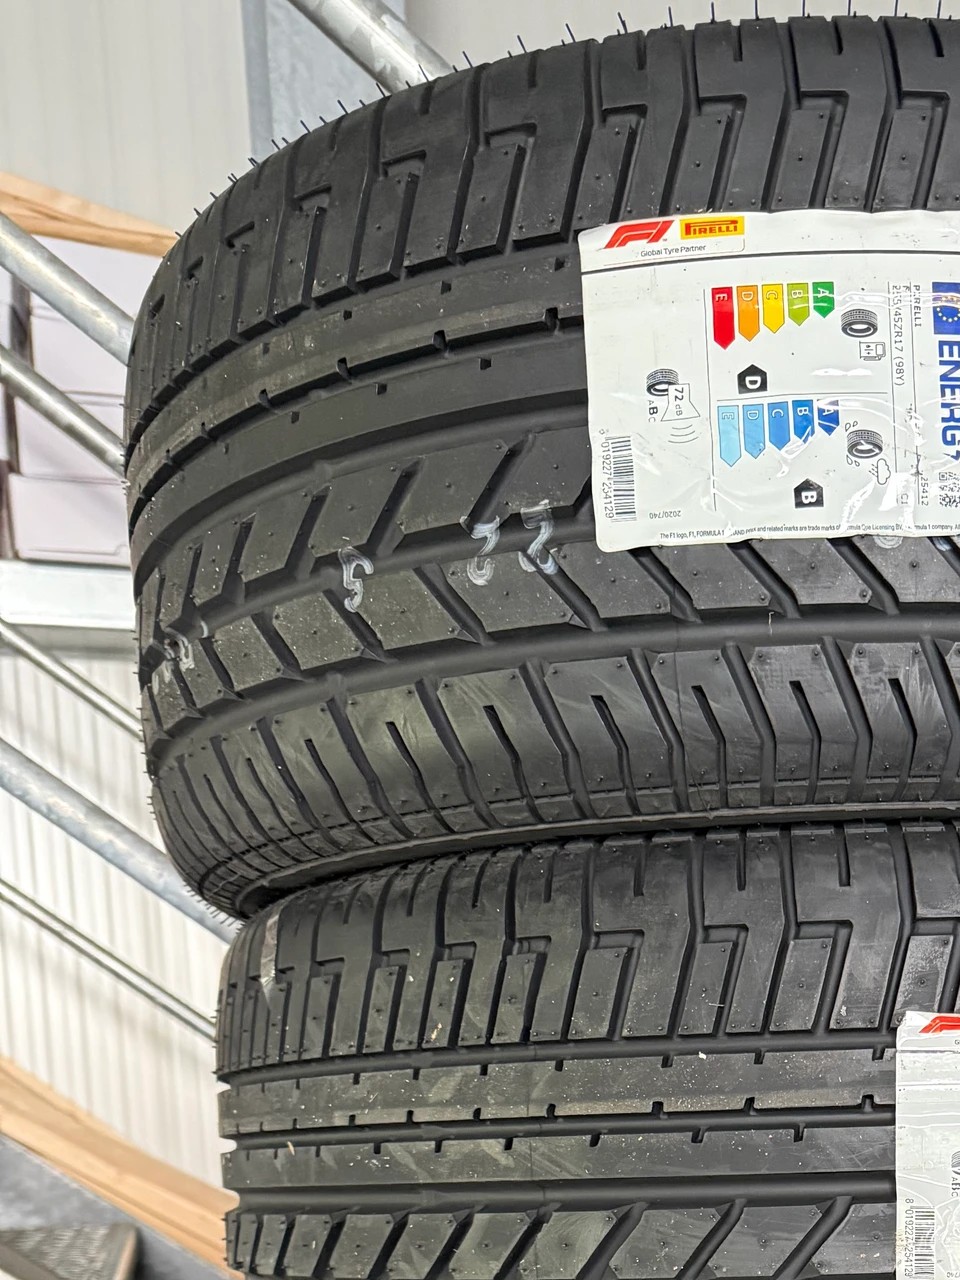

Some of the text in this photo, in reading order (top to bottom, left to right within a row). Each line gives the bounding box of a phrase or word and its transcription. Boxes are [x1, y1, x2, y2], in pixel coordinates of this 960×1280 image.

[685, 219, 738, 236] PIRELLI
[640, 244, 706, 257] Global Tyre Partner
[716, 293, 728, 302] E
[741, 291, 753, 301] D
[766, 290, 778, 300] C
[791, 289, 803, 299] B
[817, 287, 829, 298] A
[893, 356, 905, 386] (98Y)
[745, 376, 762, 389] D
[674, 387, 684, 416] 72 dB
[722, 412, 734, 420] E
[747, 410, 759, 420] D
[772, 408, 784, 418] C
[797, 406, 809, 416] B
[801, 491, 817, 504] B
[649, 510, 682, 519] 2020/740
